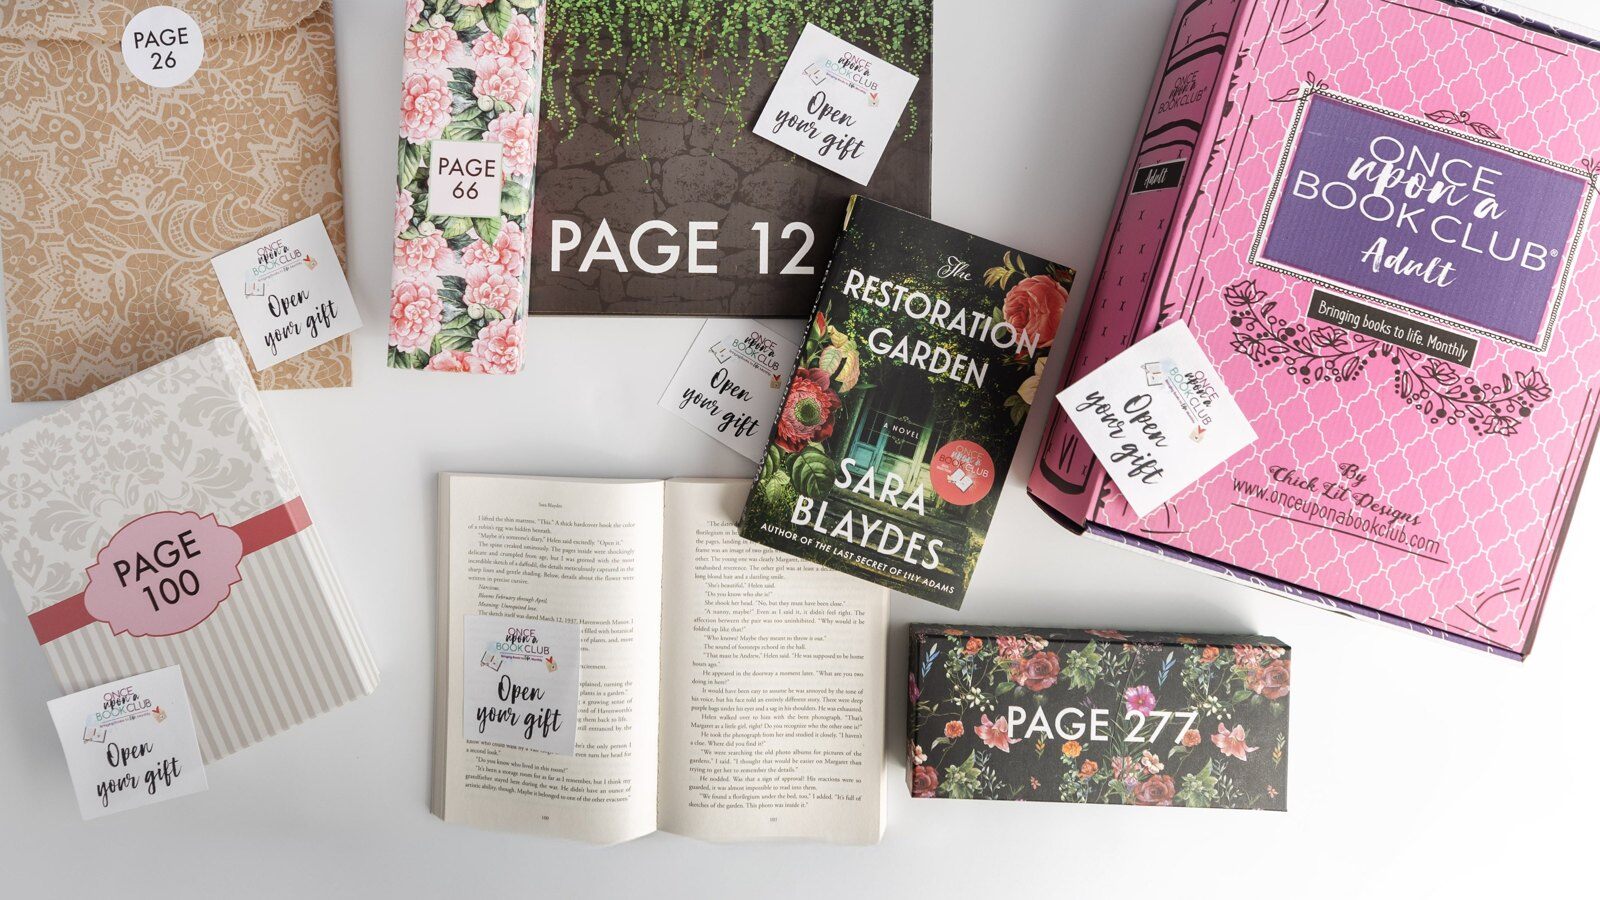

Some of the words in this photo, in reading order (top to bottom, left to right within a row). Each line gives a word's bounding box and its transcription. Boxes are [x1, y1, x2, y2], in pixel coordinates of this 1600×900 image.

[133, 27, 189, 49] PAGE
[150, 51, 176, 70] 26
[825, 59, 852, 79] BOOK
[853, 74, 878, 90] CLUB
[838, 57, 863, 72] upon
[863, 69, 871, 77] a
[844, 52, 872, 69] ONCE
[1175, 70, 1199, 88] ONCE
[807, 91, 856, 127] Open
[772, 109, 822, 140] your
[818, 133, 866, 160] gift
[439, 157, 496, 178] PAGE
[1144, 168, 1168, 189] Adult
[1370, 136, 1503, 197] ONCE
[452, 181, 478, 199] 66
[1292, 170, 1425, 233] BOOK
[1347, 157, 1470, 206] upon
[1473, 198, 1507, 220] a
[257, 239, 283, 256] ONCE
[258, 249, 281, 264] upon
[551, 217, 719, 274] PAGE
[751, 221, 815, 275] 12
[253, 258, 280, 276] BOOK
[279, 249, 302, 264] CLUB
[937, 255, 973, 282] The
[1361, 237, 1457, 288] Adult
[267, 288, 310, 318] Open
[843, 268, 1040, 358] RESTORATION
[264, 321, 302, 356] your
[306, 300, 338, 338] gift
[751, 331, 777, 350] ONCE
[1318, 300, 1361, 329] Bringing
[1362, 315, 1392, 336] books
[1394, 326, 1405, 339] to
[1407, 330, 1424, 346] life.
[1427, 335, 1468, 362] Monthly
[732, 339, 758, 359] BOOK
[758, 354, 779, 370] CLUB
[744, 337, 770, 352] upon
[868, 327, 989, 389] GARDEN
[710, 367, 752, 402] Open
[1170, 366, 1194, 398] BOOK
[1190, 397, 1212, 425] CLUB
[1185, 373, 1209, 398] upon
[1195, 371, 1219, 401] ONCE
[678, 388, 723, 416] your
[717, 413, 760, 438] gift
[1123, 393, 1168, 447] Open
[892, 424, 919, 440] NOVEL
[1076, 391, 1126, 439] your
[1110, 443, 1164, 485] gift
[939, 454, 964, 469] BOOK
[965, 463, 989, 478] CLUB
[956, 445, 983, 461] ONCE
[834, 457, 926, 517] SARA
[1339, 462, 1367, 488] By
[1269, 465, 1319, 493] Chick
[1322, 482, 1350, 502] Lit
[1352, 492, 1421, 526] Designs
[1232, 477, 1441, 555] www.onceuponabookclub.com
[790, 495, 944, 571] BLAYDES
[113, 529, 201, 588] PAGE
[760, 523, 797, 542] AUTHOR
[800, 536, 813, 547] OF
[815, 541, 832, 554] THE
[833, 547, 854, 563] LAST
[855, 555, 888, 572] SECRET
[889, 567, 902, 577] OF
[903, 571, 921, 584] LILY
[922, 577, 955, 594] ADAMS
[142, 569, 200, 612] 100
[505, 634, 531, 645] upon
[532, 636, 539, 644] a
[508, 627, 536, 638] ONCE
[496, 642, 524, 652] BOOK
[524, 644, 550, 655] CLUB
[103, 685, 134, 701] ONCE
[104, 695, 130, 710] upon
[498, 674, 545, 704] Open
[96, 705, 127, 721] BOOK
[126, 698, 151, 712] CLUB
[476, 706, 521, 734] your
[523, 708, 563, 740] gift
[1008, 705, 1109, 741] PAGE
[1124, 709, 1199, 745] 277
[106, 742, 154, 768] Open
[97, 773, 140, 808] your
[144, 757, 182, 795] gift
